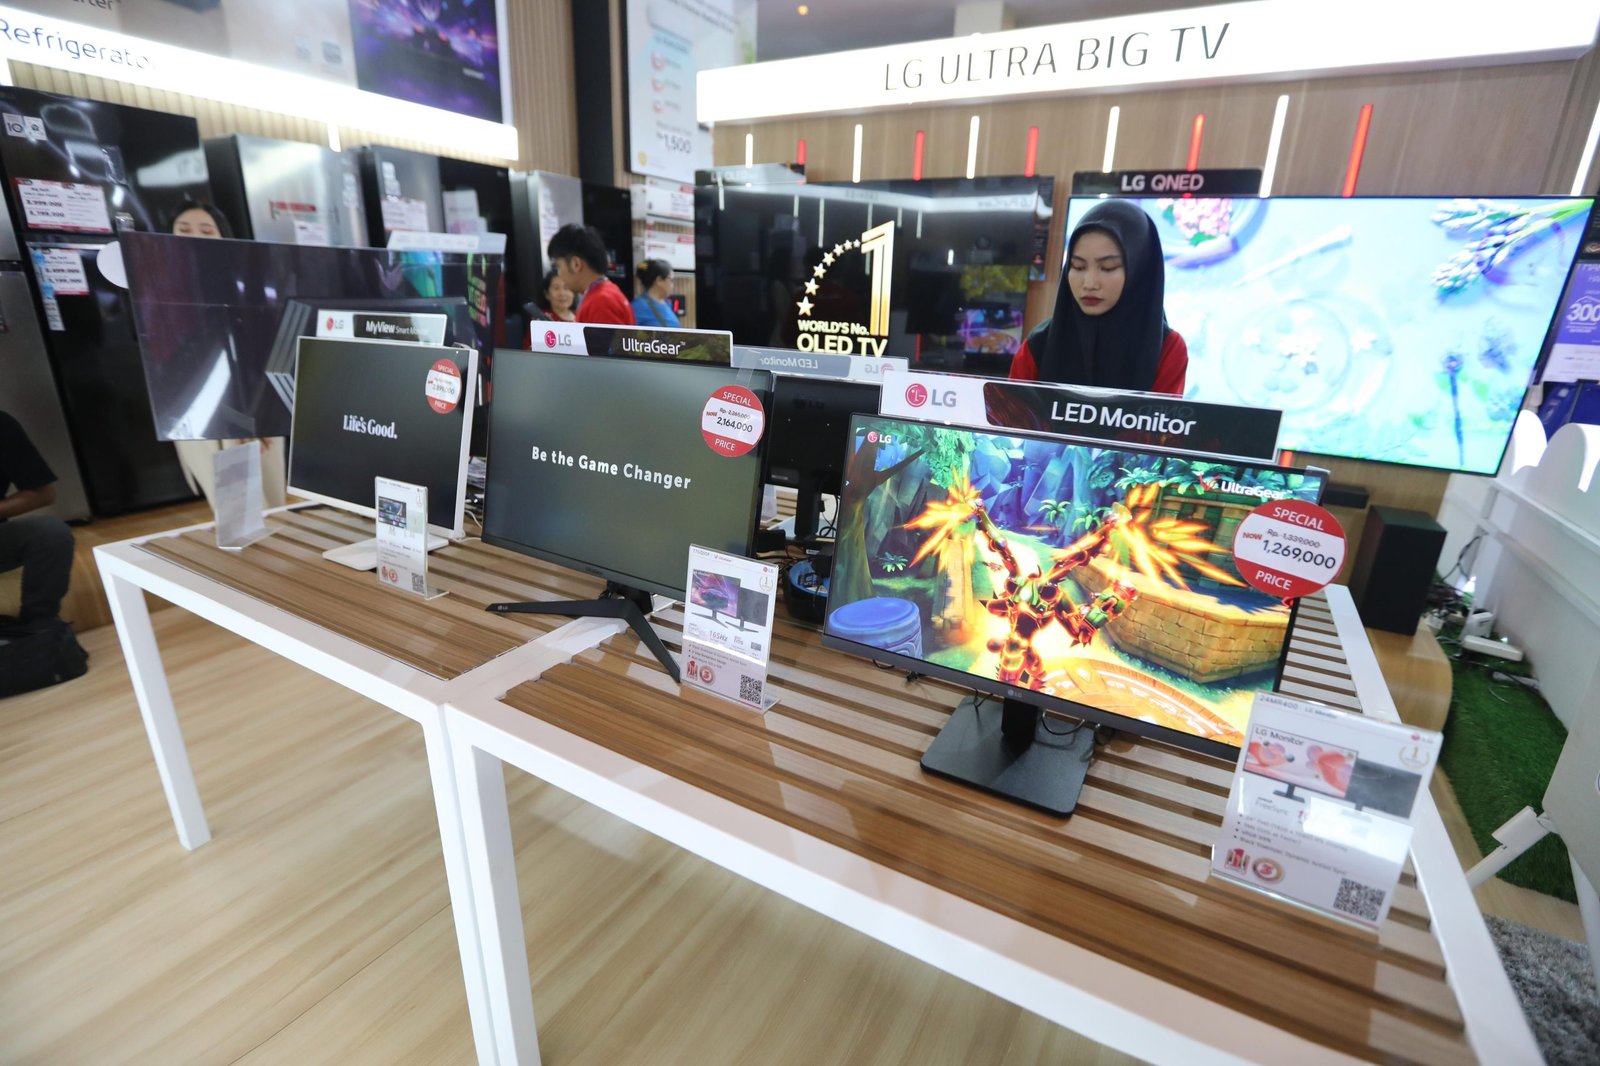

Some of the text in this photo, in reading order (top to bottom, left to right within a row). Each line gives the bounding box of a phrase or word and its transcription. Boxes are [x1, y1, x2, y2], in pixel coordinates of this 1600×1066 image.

[885, 22, 1230, 90] LG ULTRA BIG TV
[1121, 173, 1205, 192] LG QNED
[366, 320, 396, 335] MyView
[797, 319, 850, 334] WORLD'S
[850, 322, 870, 336] No.
[558, 334, 572, 346] LG
[797, 333, 888, 358] OLED TV
[722, 391, 752, 406] SPECIAL
[931, 388, 1197, 436] LG LED Monitor
[343, 414, 398, 439] Life's Good.
[717, 416, 753, 433] 2,164,000
[714, 438, 736, 451] PRICE
[879, 433, 892, 444] LG
[531, 446, 692, 490] Be the Game Changer
[1272, 507, 1324, 531] SPECIAL
[1242, 531, 1336, 569] NOW 1,269,000
[1255, 570, 1292, 590] PRICE
[1255, 727, 1305, 746] LG Monitor
